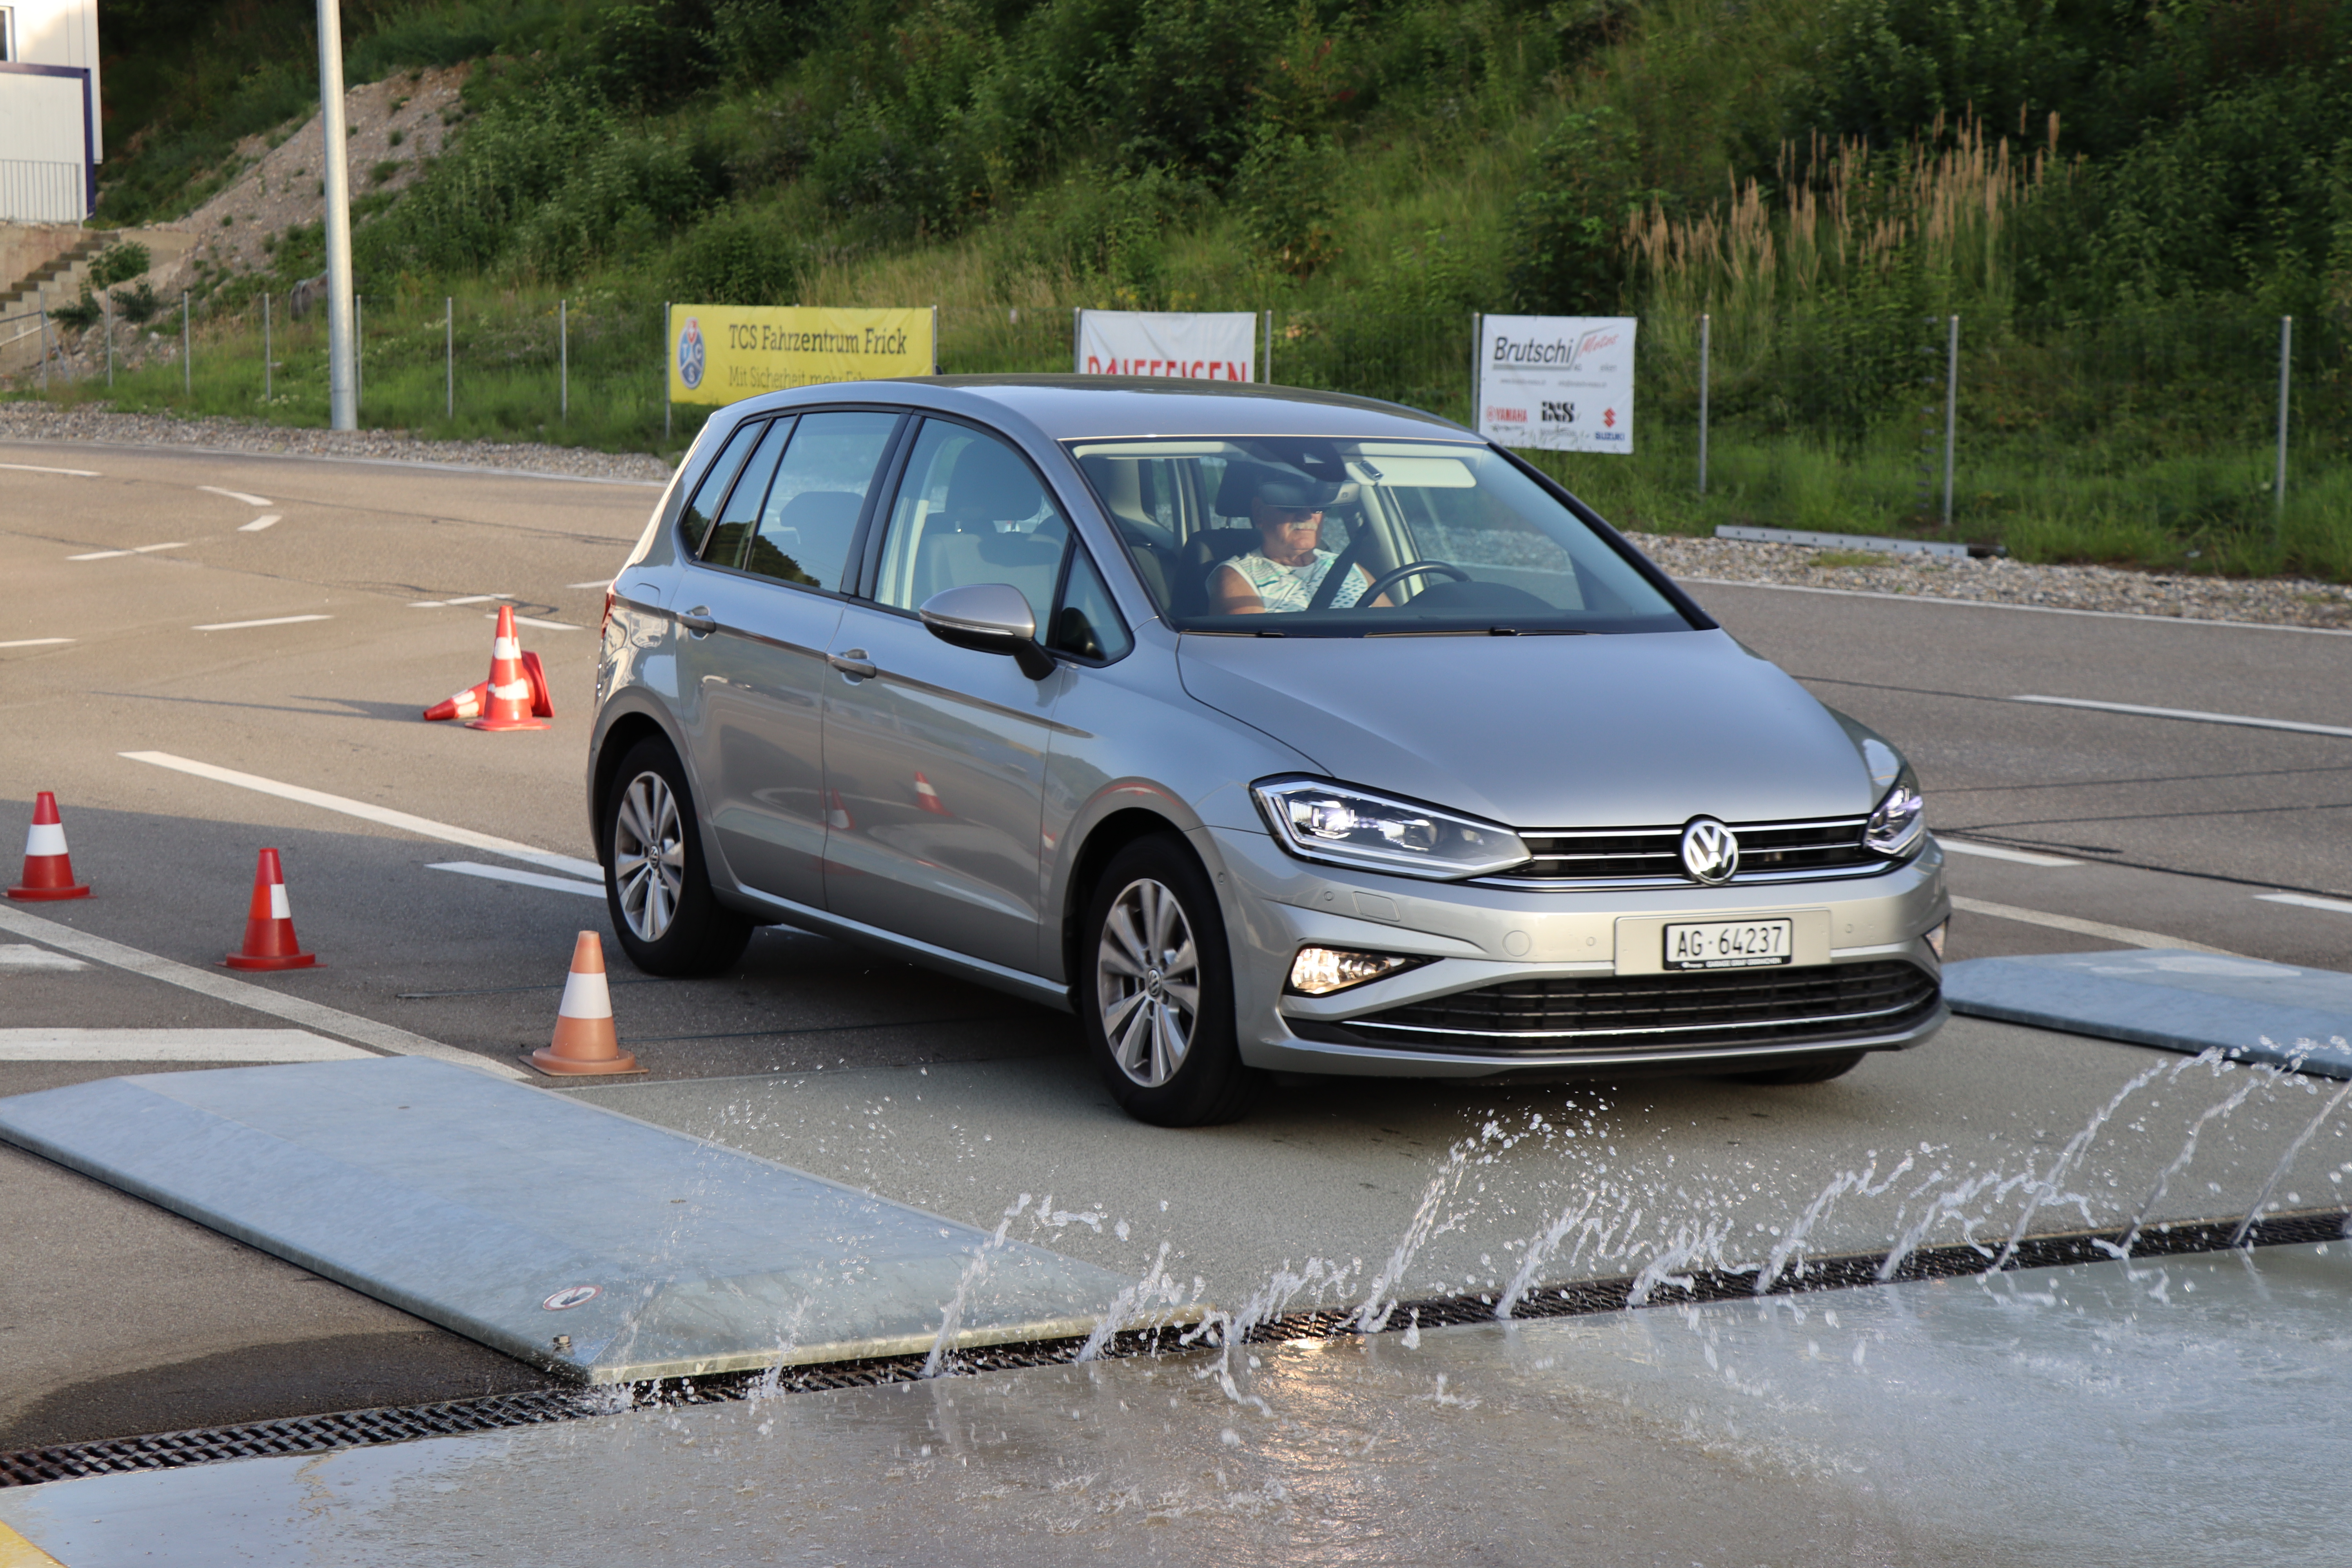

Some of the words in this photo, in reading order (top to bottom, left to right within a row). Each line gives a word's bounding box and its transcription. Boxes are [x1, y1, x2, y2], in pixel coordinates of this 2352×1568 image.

[729, 324, 757, 349] TCS
[762, 325, 859, 354] Fahrzentrum
[864, 328, 907, 354] Frick
[1494, 336, 1573, 363] Brutschi
[729, 365, 748, 386] Mit
[750, 366, 805, 388] Sicherheit
[1496, 408, 1528, 423] YAMAHA
[1595, 432, 1625, 441] SUZUKI
[1677, 930, 1702, 958] AG
[1719, 926, 1782, 955] 64237
